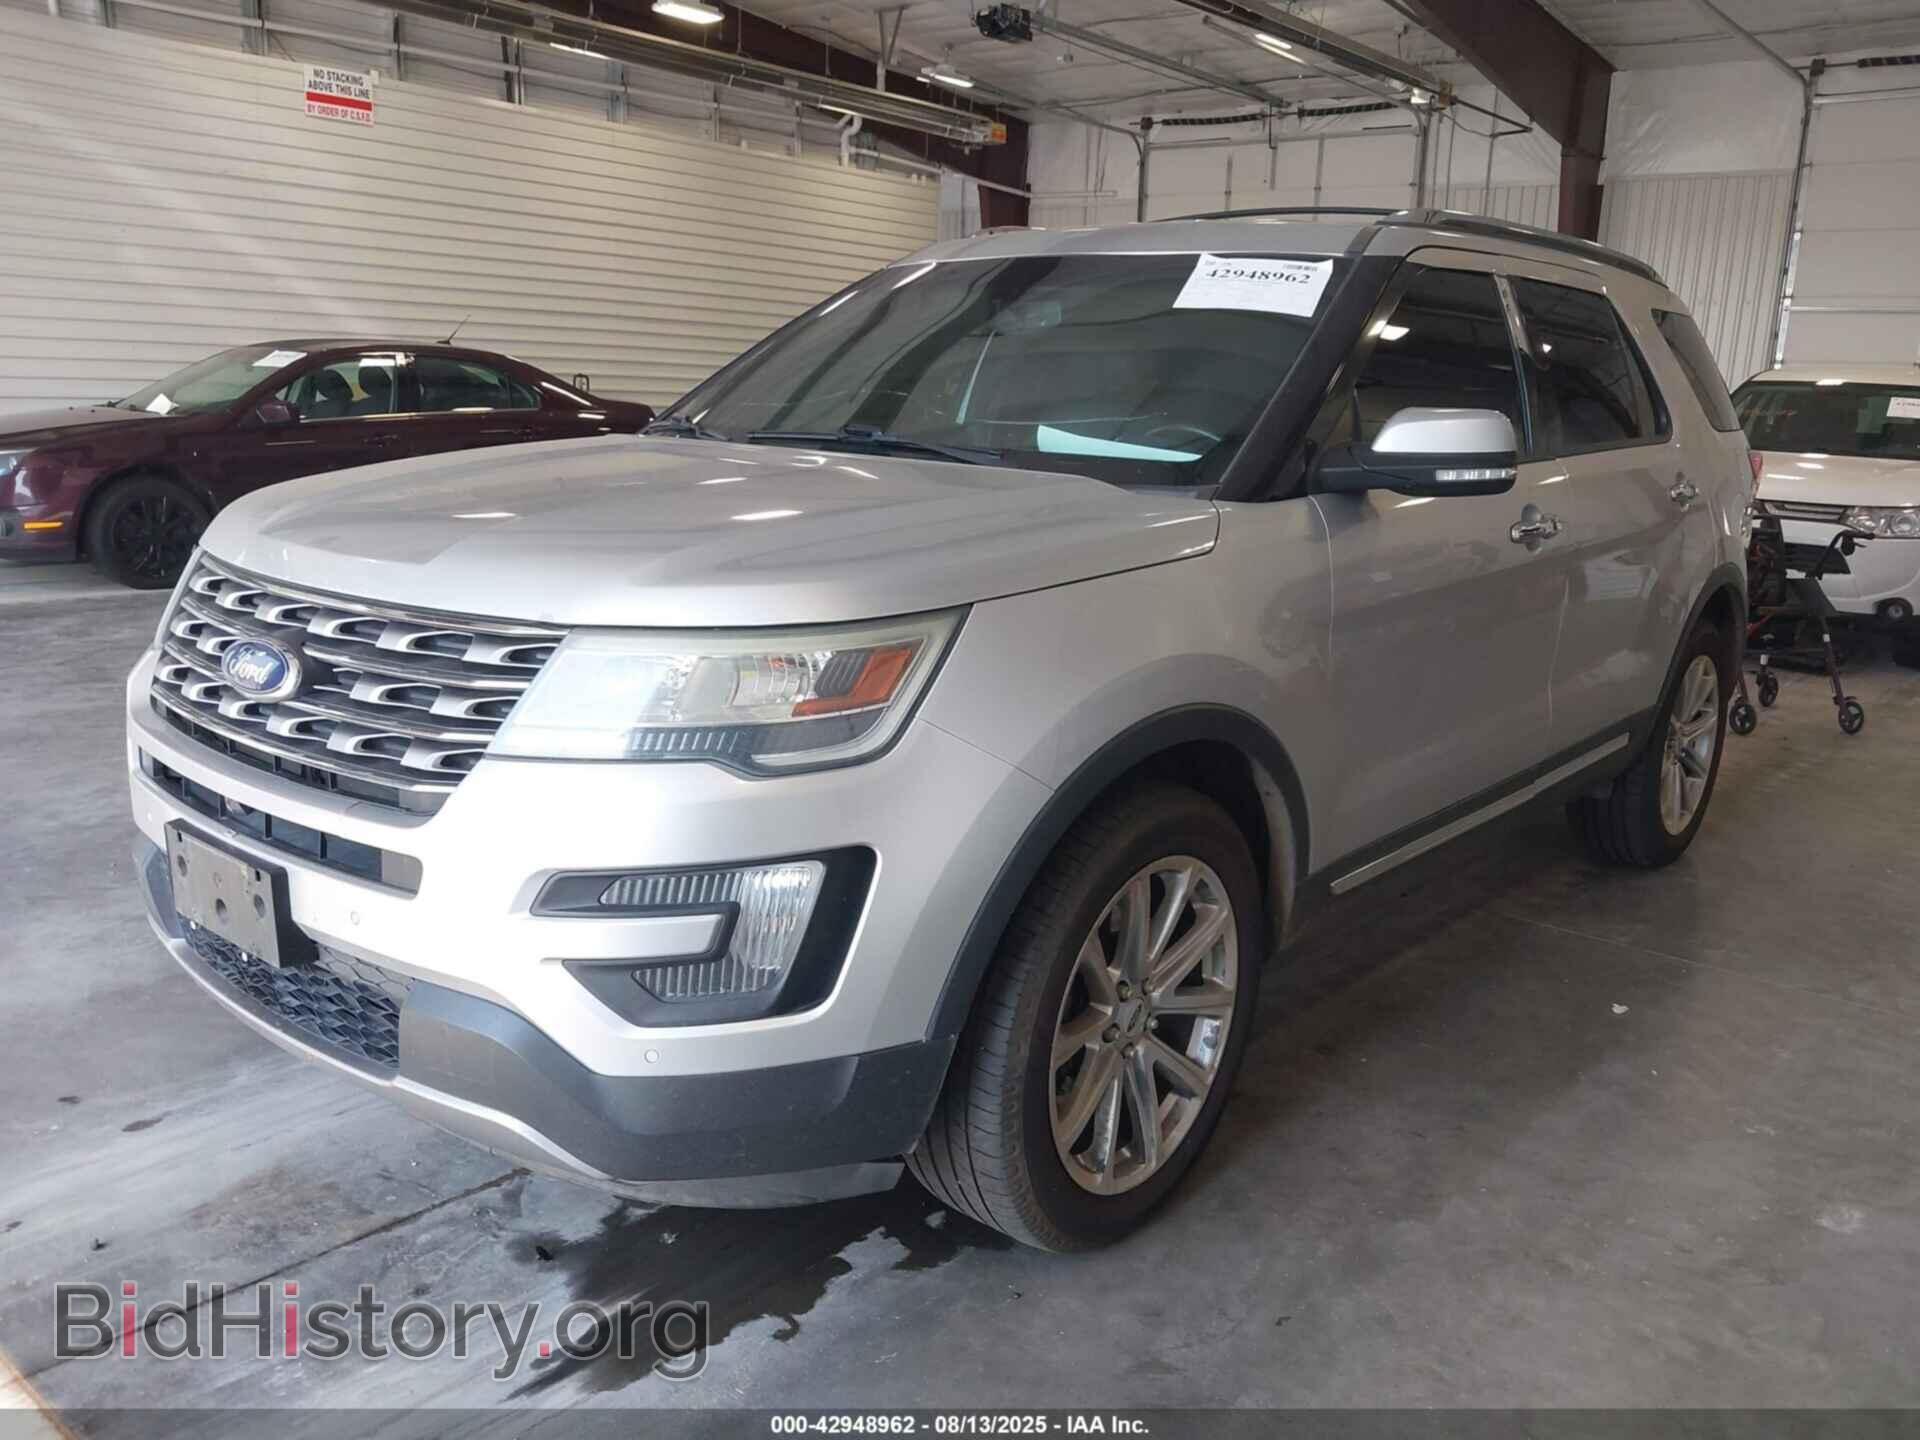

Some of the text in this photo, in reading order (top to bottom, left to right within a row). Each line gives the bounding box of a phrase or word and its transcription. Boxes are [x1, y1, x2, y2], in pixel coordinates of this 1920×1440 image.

[313, 68, 364, 87] NO STACKING
[308, 80, 370, 99] ABOVE THIS LINE
[1206, 268, 1311, 284] 42948962
[227, 646, 276, 685] Ford
